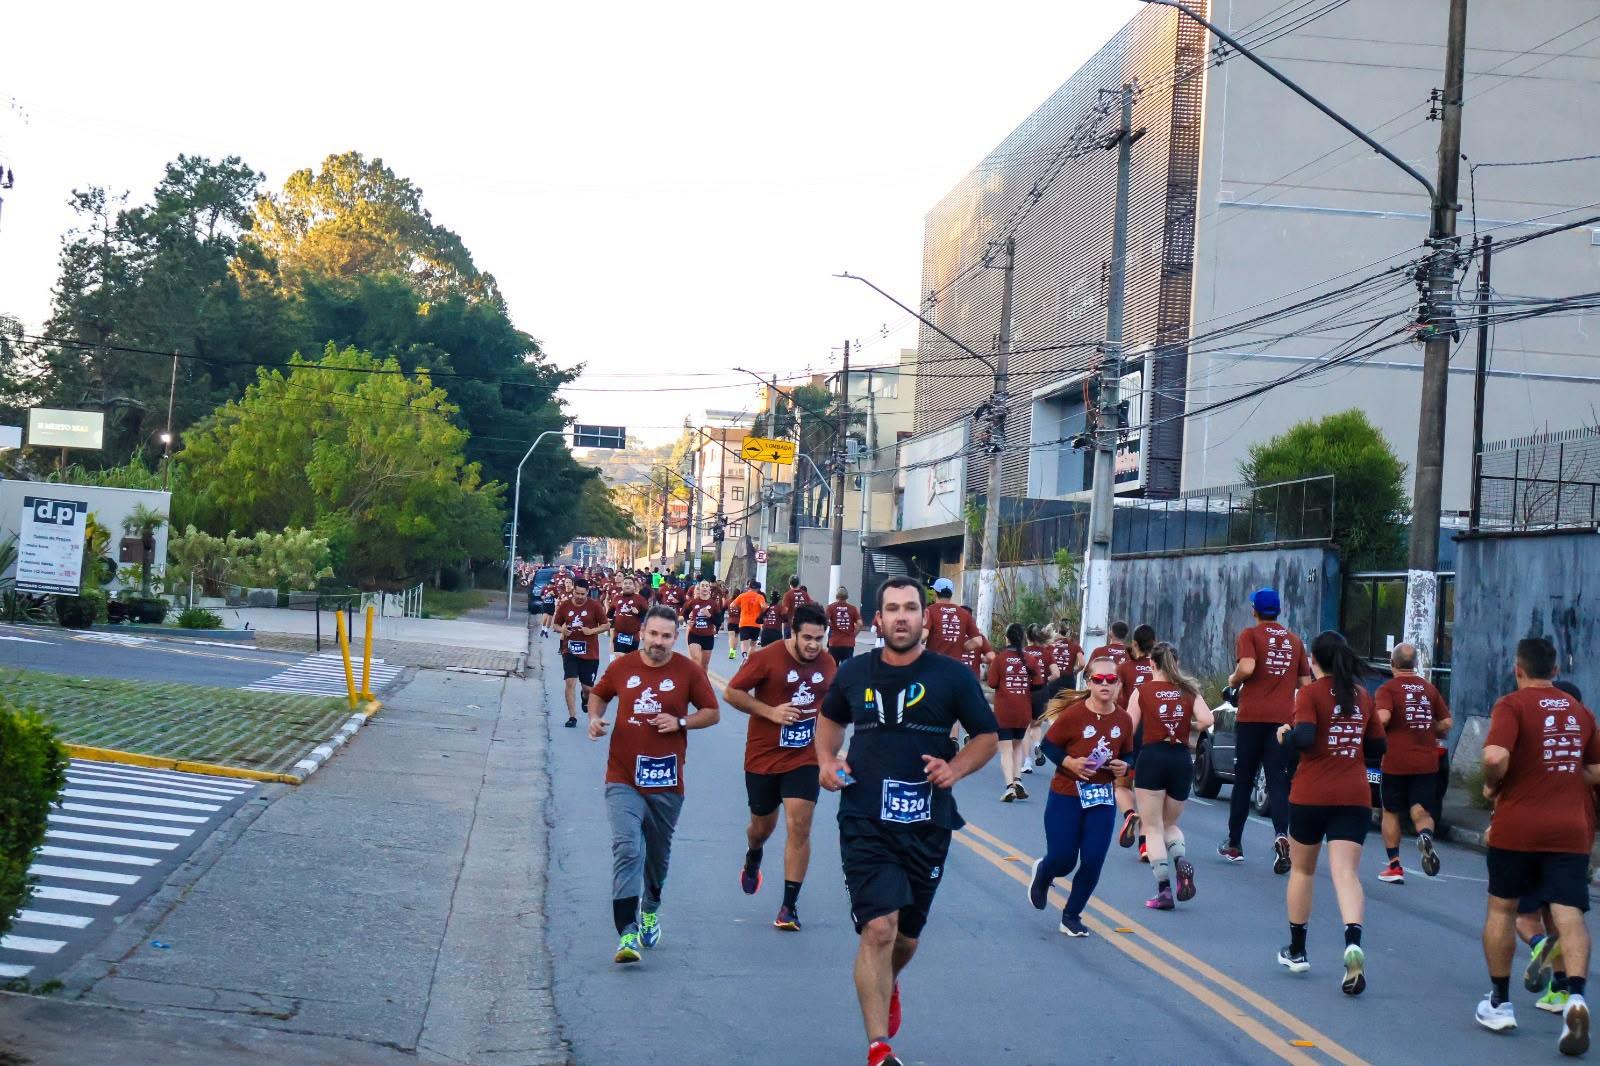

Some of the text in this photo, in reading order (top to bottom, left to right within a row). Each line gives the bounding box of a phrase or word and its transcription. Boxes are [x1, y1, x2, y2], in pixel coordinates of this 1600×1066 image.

[787, 729, 811, 741] 5251
[642, 768, 671, 779] 5694
[1085, 788, 1109, 799] 5293
[891, 797, 924, 813] 5320
